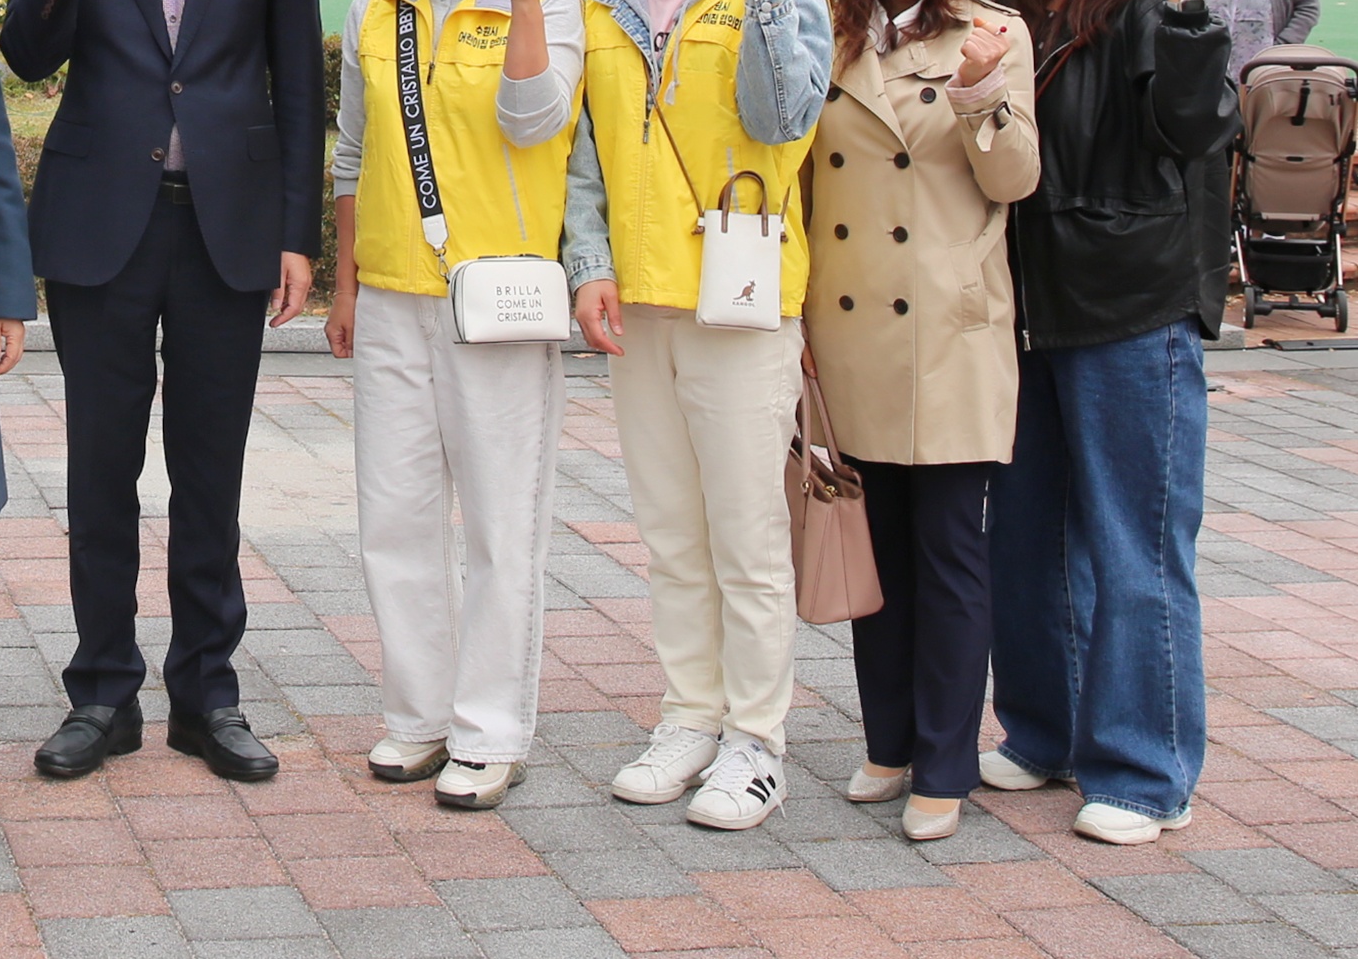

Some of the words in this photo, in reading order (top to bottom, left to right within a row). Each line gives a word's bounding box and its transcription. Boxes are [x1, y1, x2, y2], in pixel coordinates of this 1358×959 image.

[475, 25, 499, 37] 수원시
[458, 31, 488, 49] 어린이집
[400, 38, 420, 118] CRISTALLO
[408, 123, 425, 149] UN
[413, 152, 437, 209] COME
[496, 285, 542, 297] BRILLA
[496, 299, 527, 310] COME
[529, 299, 542, 309] UN
[497, 311, 544, 323] CRISTALLO
